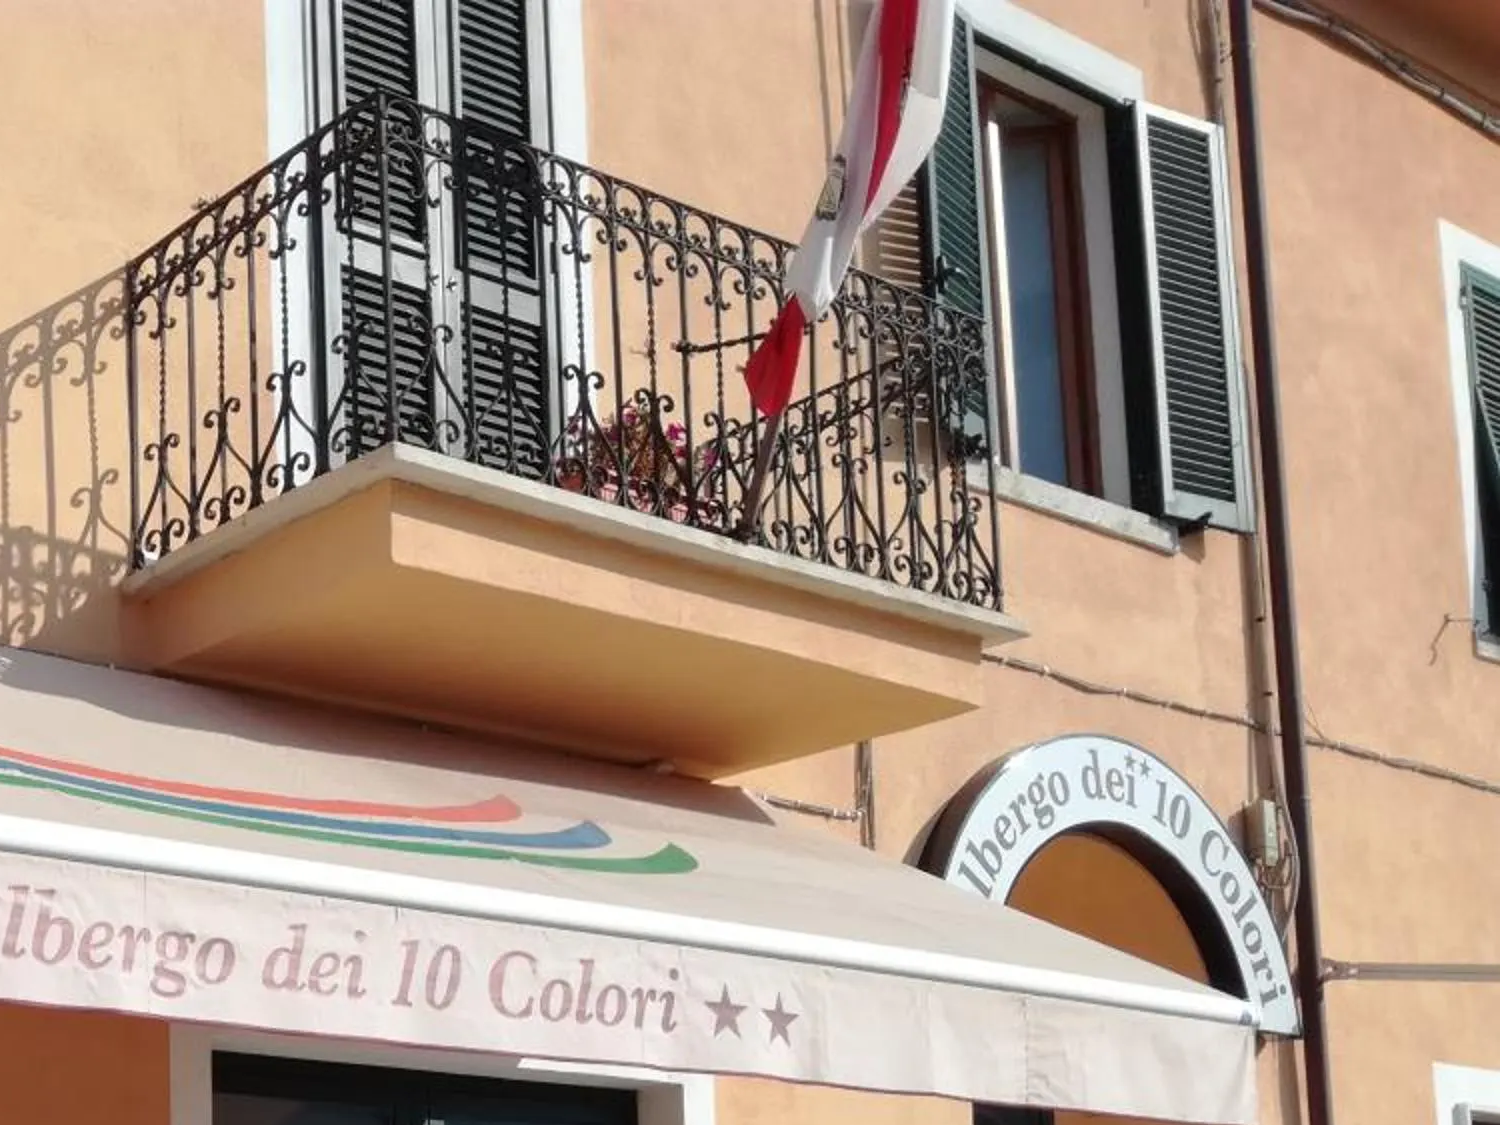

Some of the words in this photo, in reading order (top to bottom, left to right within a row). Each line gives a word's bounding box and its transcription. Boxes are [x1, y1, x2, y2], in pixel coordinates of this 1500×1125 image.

[957, 770, 1071, 899] lbergo
[1080, 749, 1139, 810] dei
[1152, 779, 1192, 840] 10
[1199, 828, 1287, 1008] Colori
[261, 923, 367, 999] dei
[392, 939, 462, 1010] 10
[487, 950, 680, 1034] Colori
